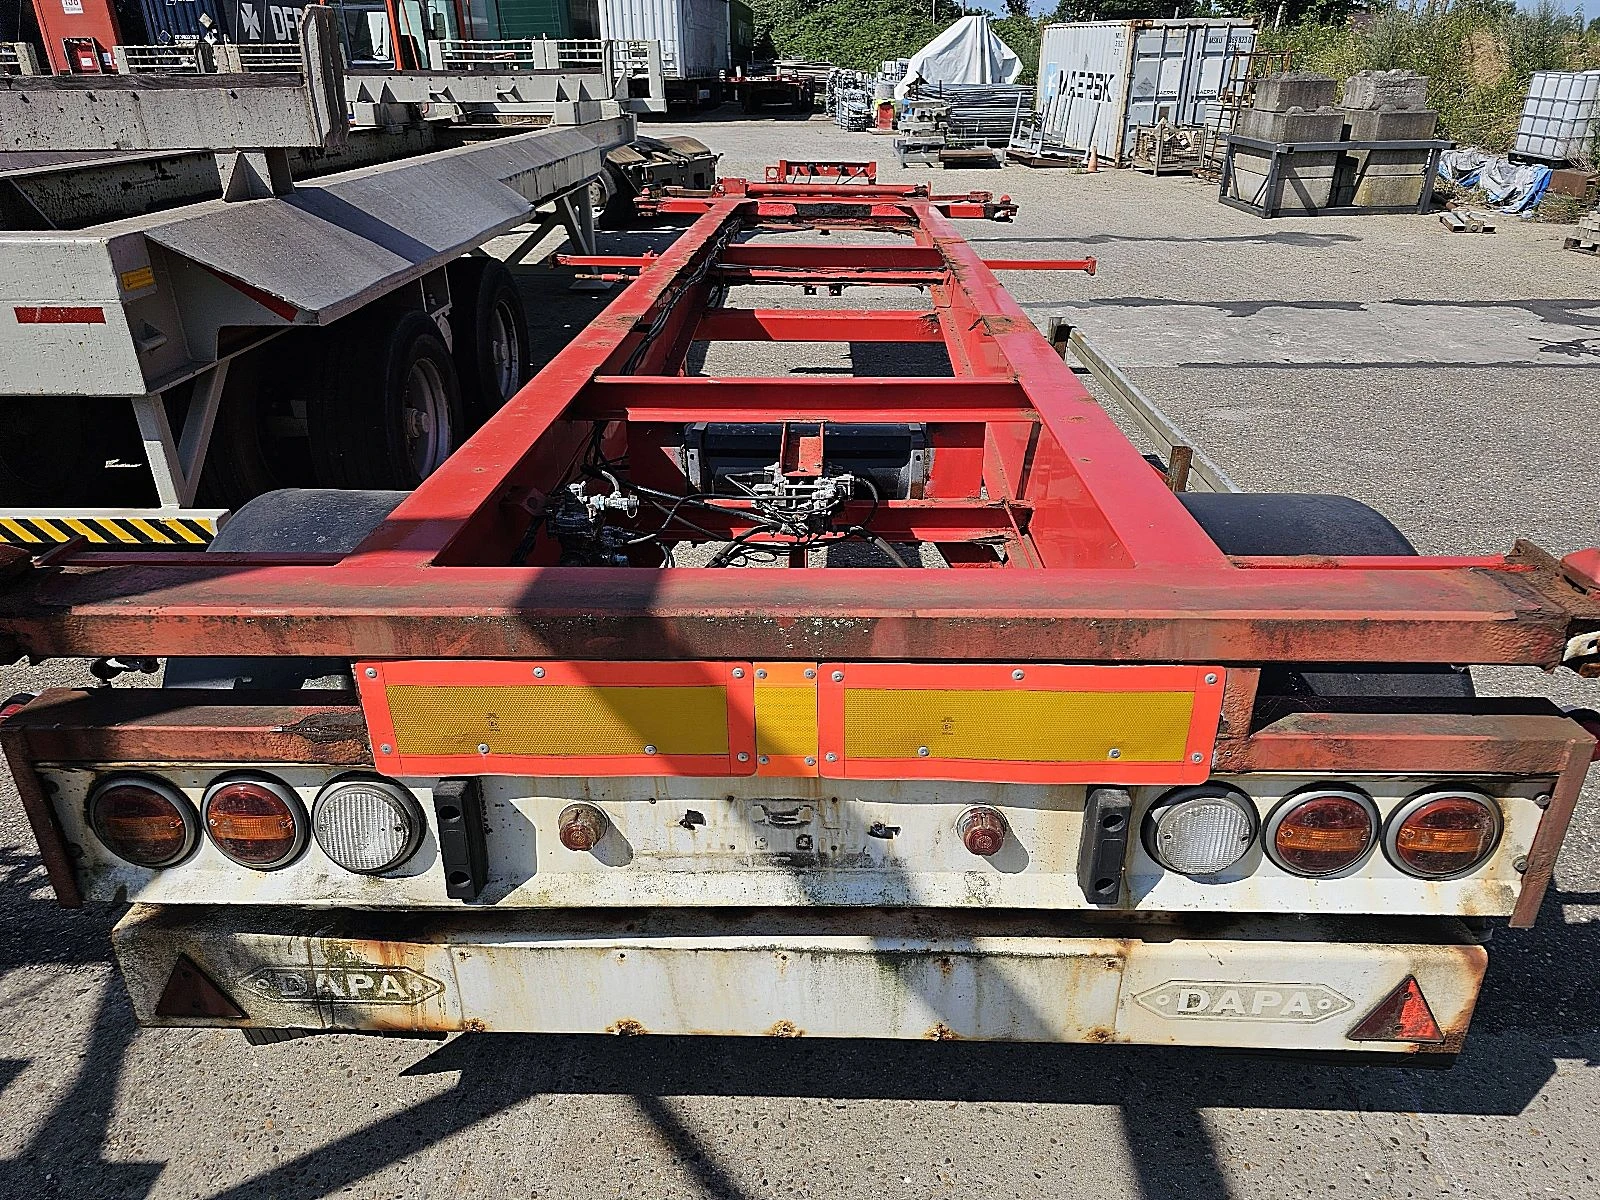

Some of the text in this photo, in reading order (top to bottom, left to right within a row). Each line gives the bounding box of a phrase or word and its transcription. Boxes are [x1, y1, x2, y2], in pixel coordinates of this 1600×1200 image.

[1059, 70, 1115, 102] MAERSK
[279, 972, 405, 998] DAPA
[1177, 987, 1314, 1017] DAPA
